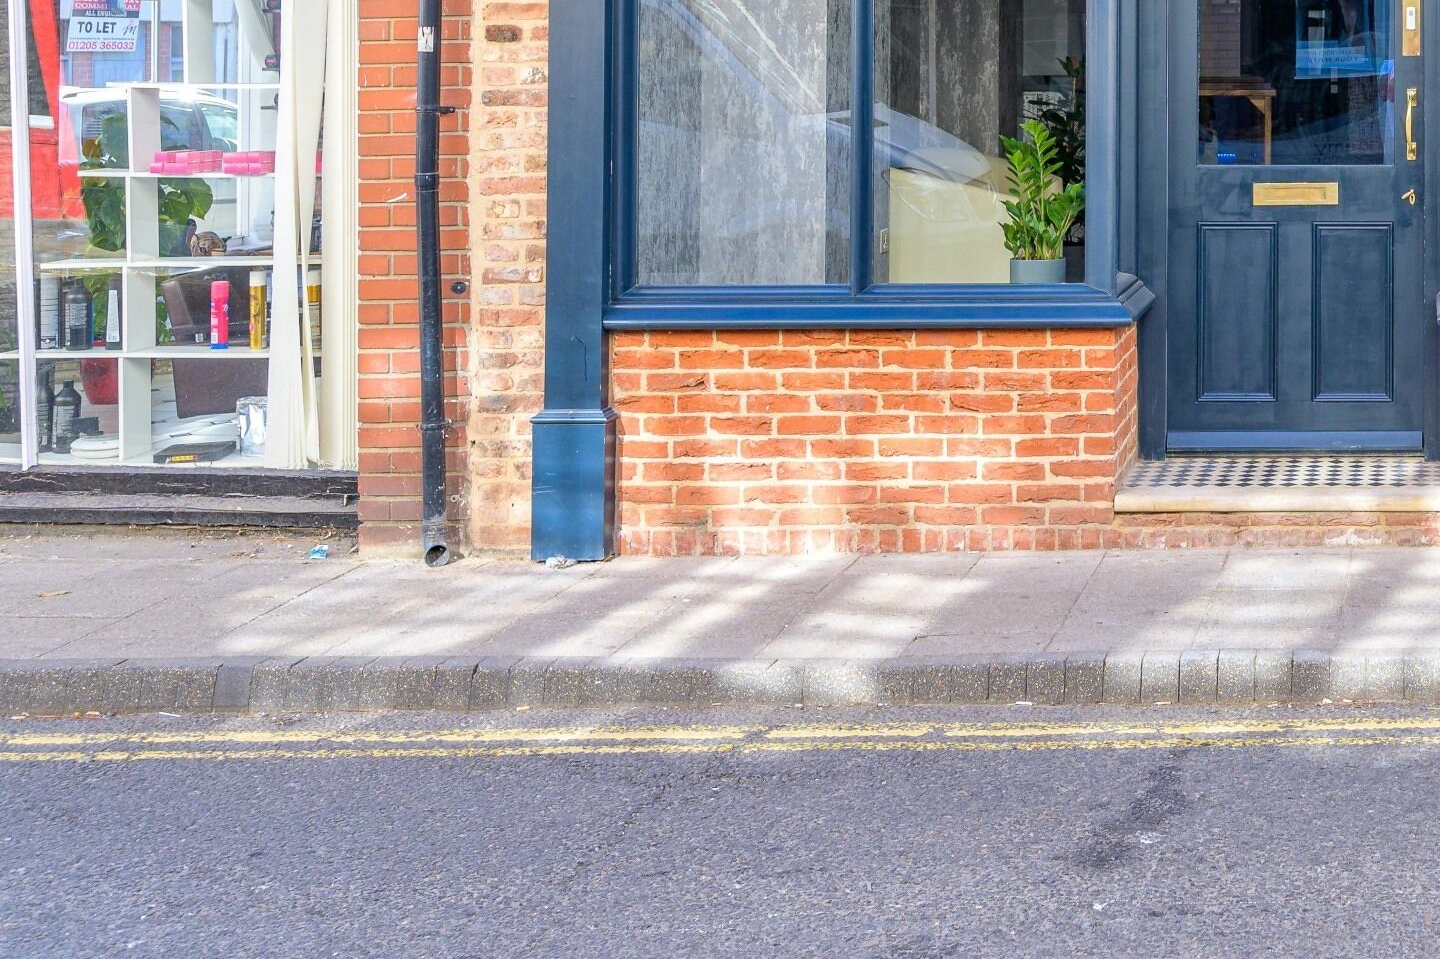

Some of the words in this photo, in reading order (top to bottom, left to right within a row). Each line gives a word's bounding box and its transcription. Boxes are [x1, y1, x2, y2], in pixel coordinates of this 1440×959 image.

[77, 21, 93, 34] TO
[96, 21, 117, 34] LET
[68, 41, 98, 51] 01205
[99, 41, 135, 51] 365032
